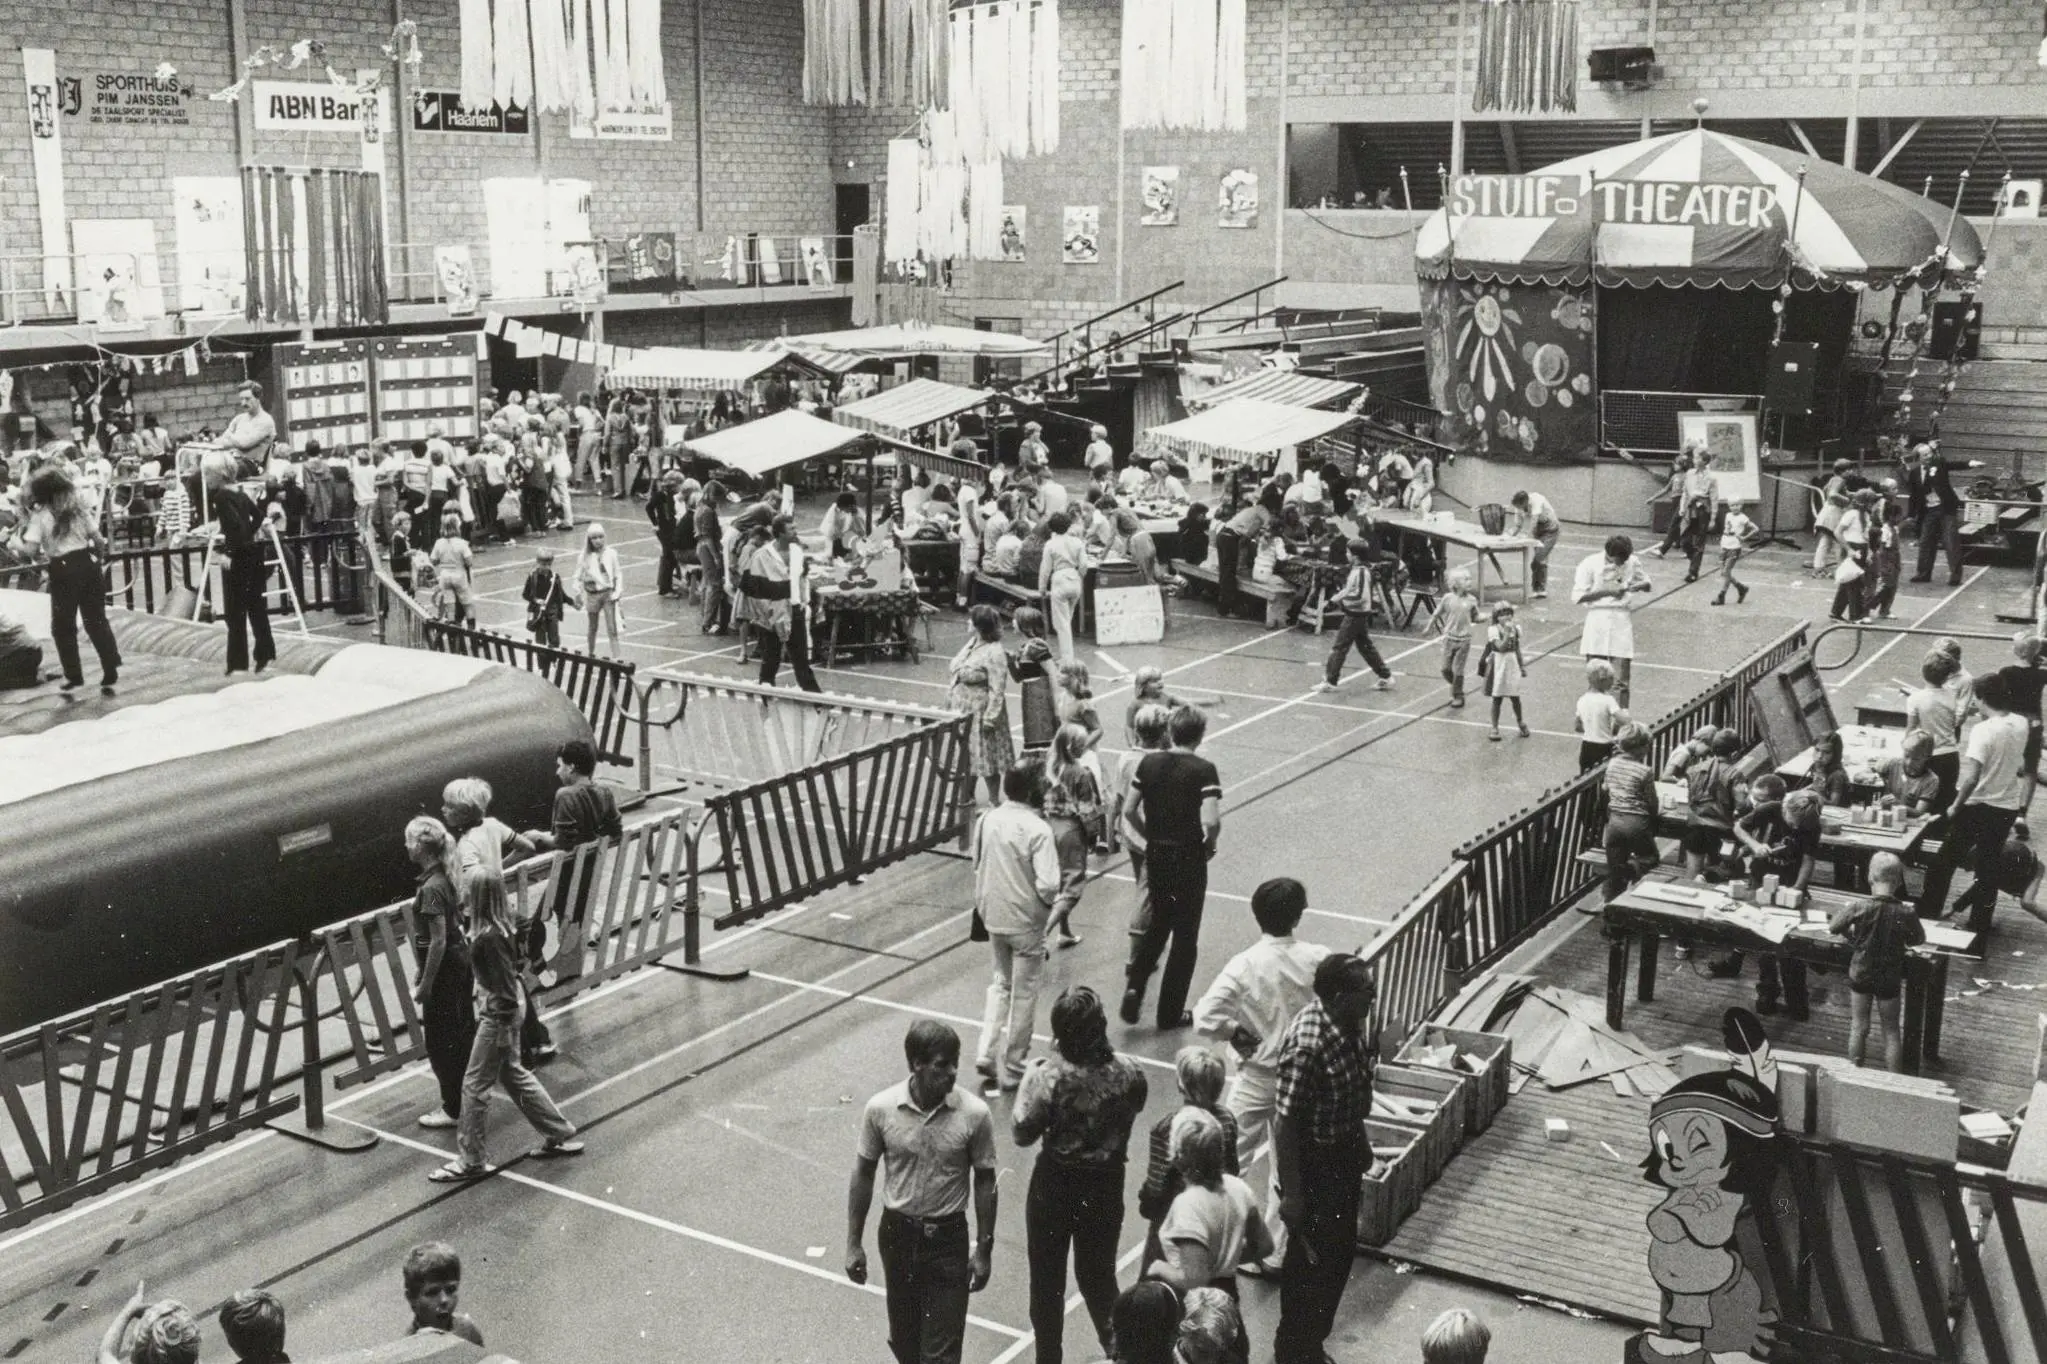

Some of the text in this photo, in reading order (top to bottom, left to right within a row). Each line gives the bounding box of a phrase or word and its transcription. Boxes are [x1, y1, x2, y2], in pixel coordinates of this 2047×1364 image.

[96, 75, 178, 92] SPORTHUIS
[97, 93, 179, 106] PIM JANSSEN
[270, 95, 316, 119] ABN
[104, 106, 145, 115] ZAALSPORT
[447, 109, 499, 127] Haarlem
[1594, 181, 1776, 228] THEATER
